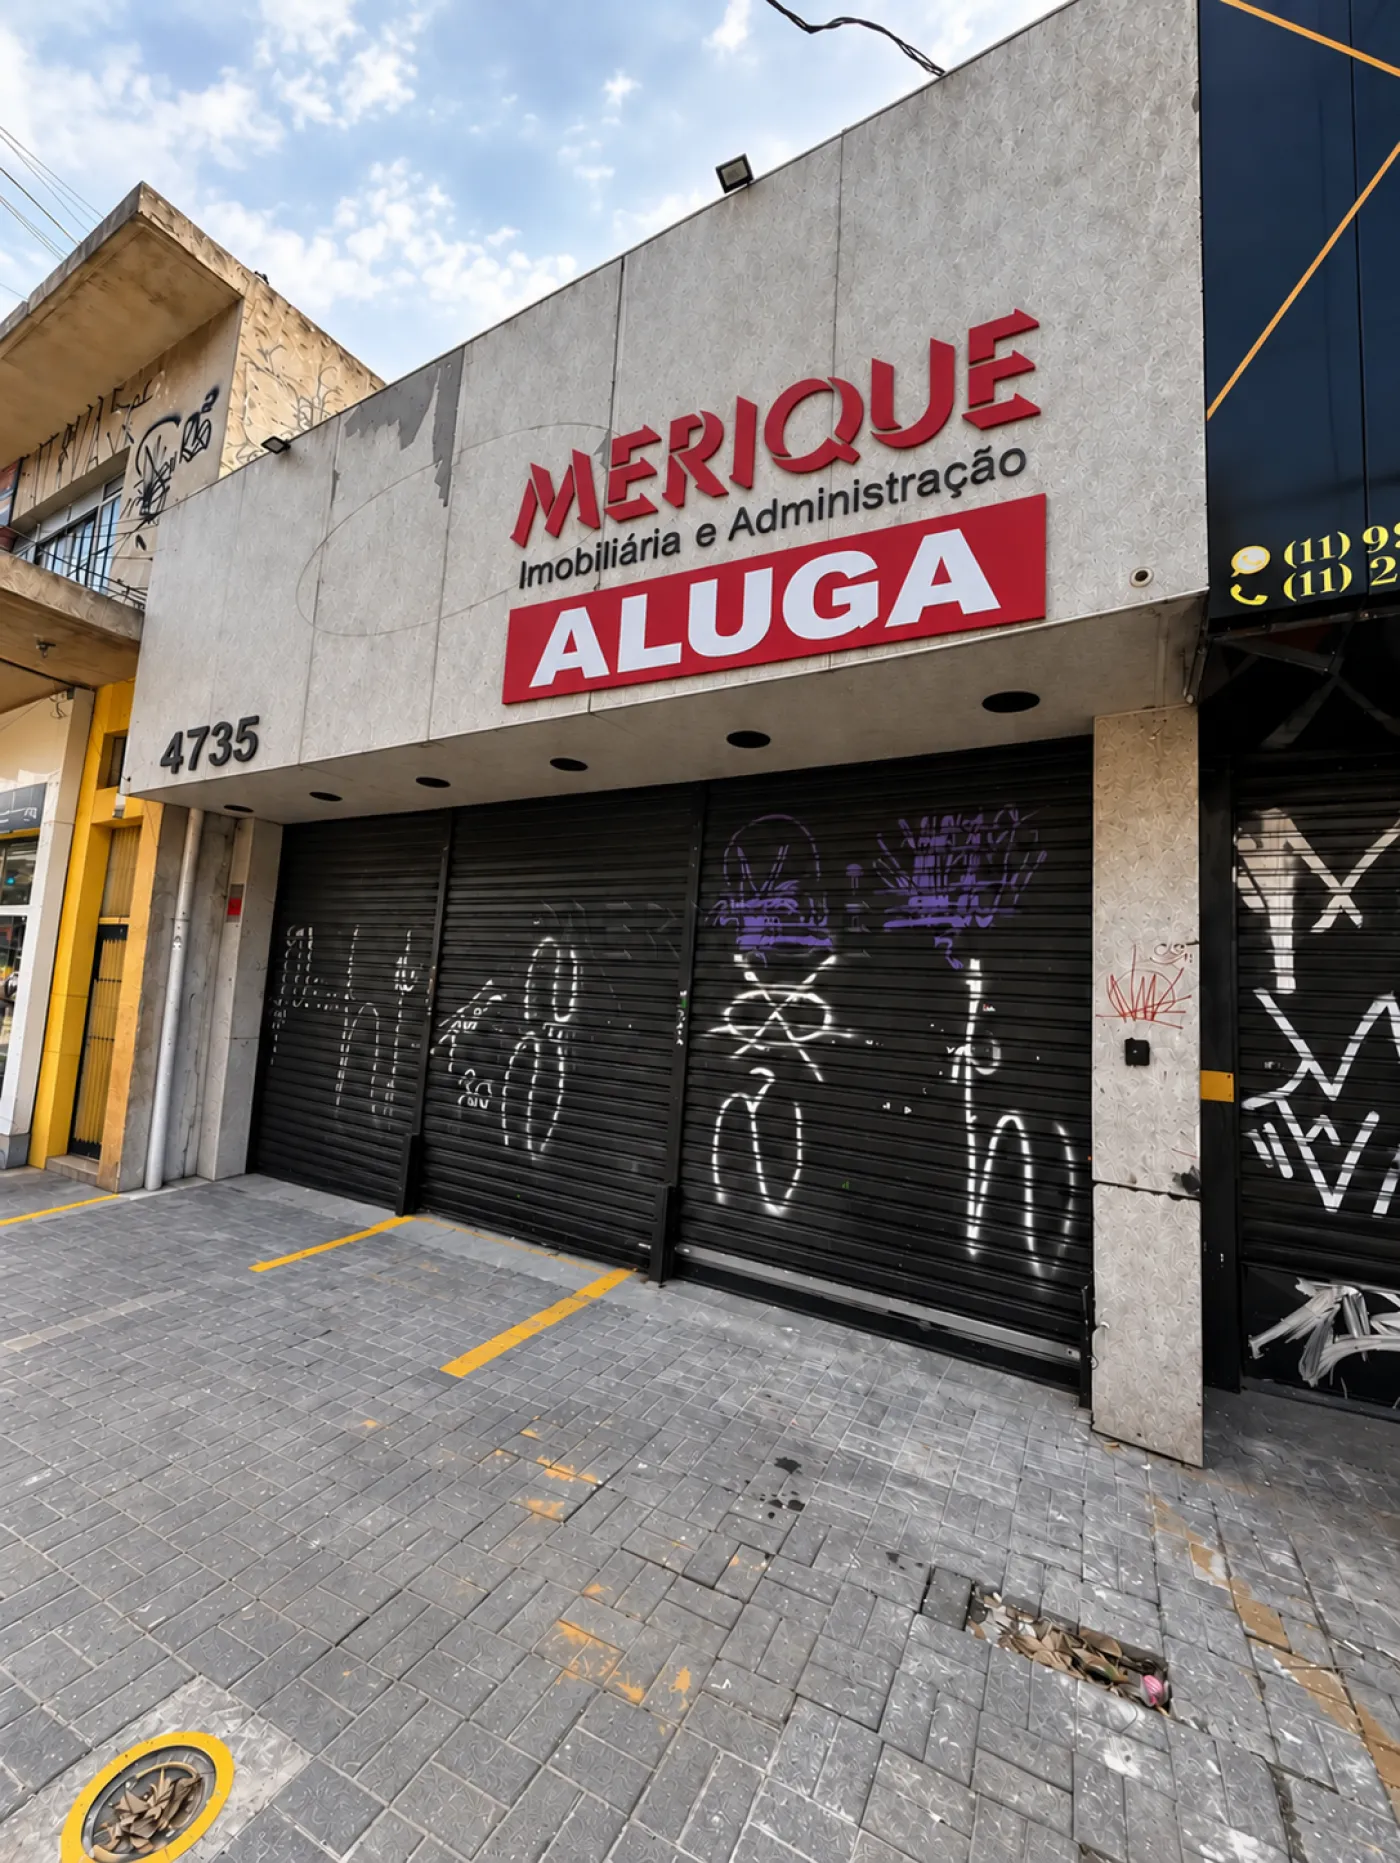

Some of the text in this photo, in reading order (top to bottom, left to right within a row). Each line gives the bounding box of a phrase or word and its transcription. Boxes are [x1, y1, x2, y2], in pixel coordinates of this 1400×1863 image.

[510, 308, 1042, 548] MERIQUE
[519, 446, 1028, 590] Imobiliária e Administração
[1284, 522, 1400, 568] (11) 9
[528, 528, 1002, 688] ALUGA
[1283, 563, 1352, 602] (11)
[160, 715, 260, 775] 4735
